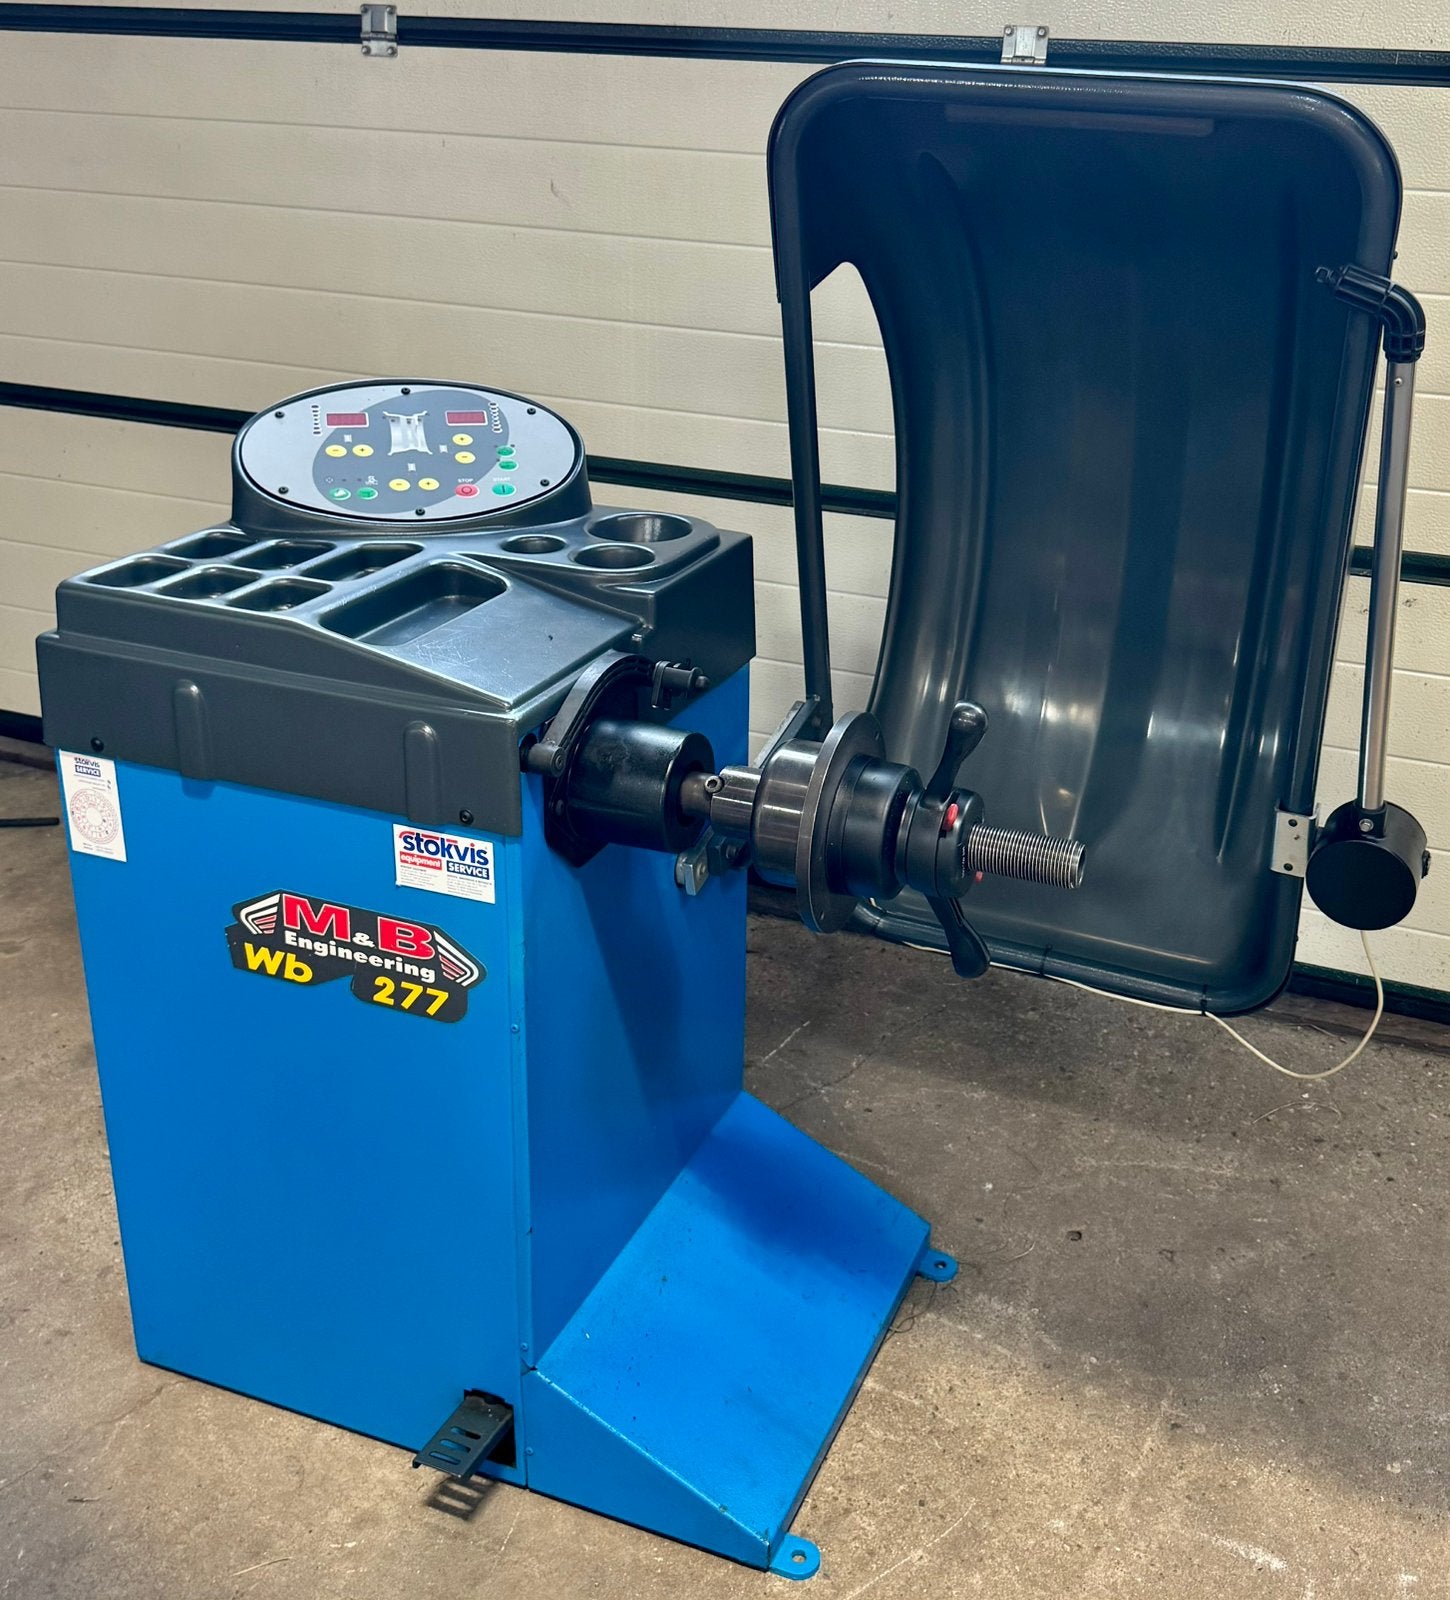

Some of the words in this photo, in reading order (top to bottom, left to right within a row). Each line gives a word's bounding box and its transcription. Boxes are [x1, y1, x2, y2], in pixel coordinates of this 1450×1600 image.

[400, 853, 442, 869] equipment
[402, 832, 489, 866] stokvis
[448, 862, 488, 878] SERVICE
[244, 942, 313, 983] Wb
[284, 930, 436, 983] Engineering
[373, 976, 449, 1016] 277
